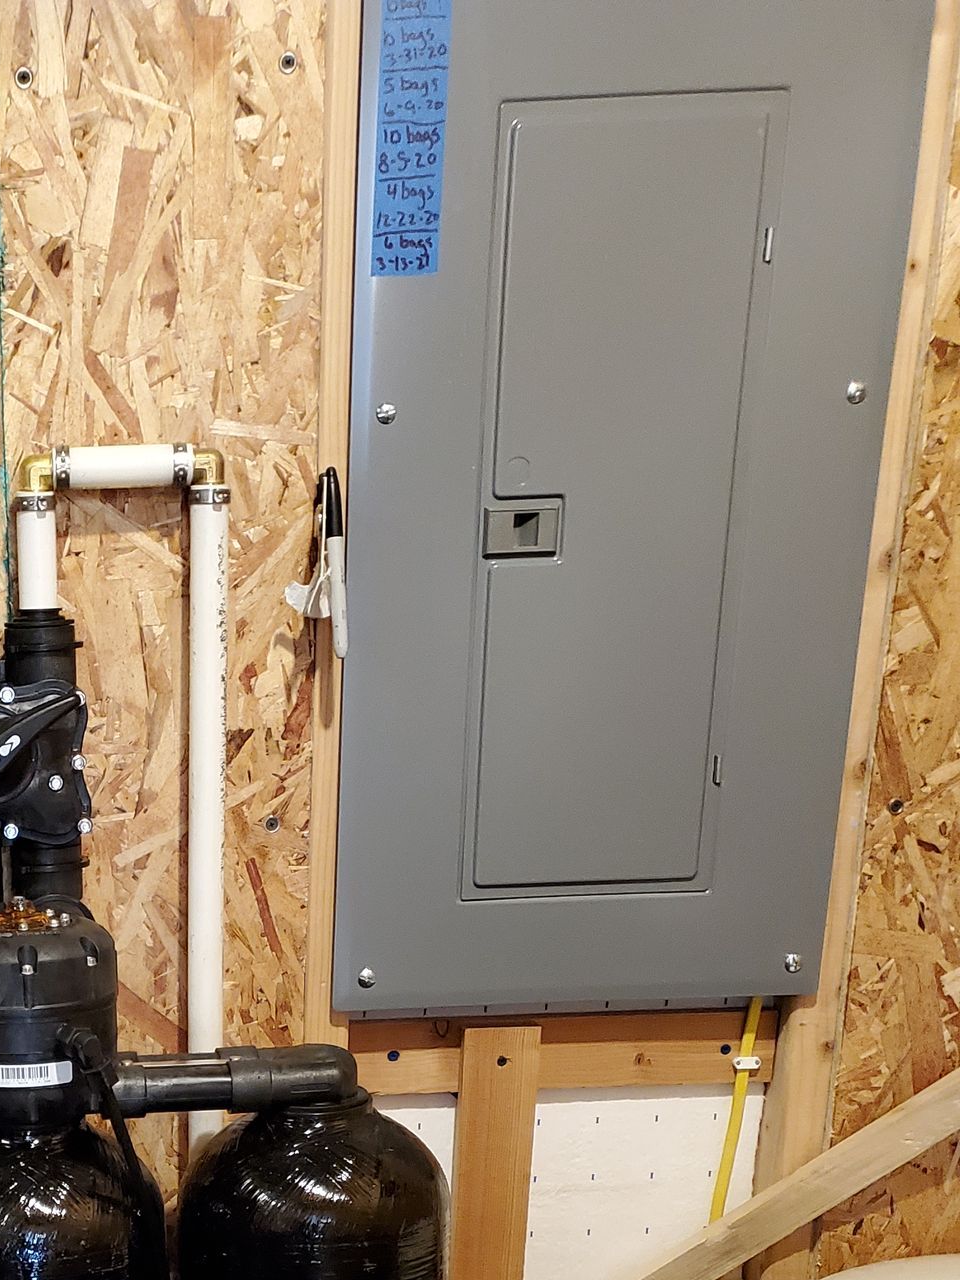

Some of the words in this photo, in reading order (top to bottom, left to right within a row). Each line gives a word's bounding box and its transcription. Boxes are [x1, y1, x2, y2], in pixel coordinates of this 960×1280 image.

[400, 26, 435, 51] bags
[383, 77, 395, 95] 5
[400, 76, 439, 97] bags
[383, 128, 402, 144] 10
[406, 125, 440, 151] bags
[387, 183, 397, 200] 4
[401, 180, 435, 210] bags
[384, 236, 393, 249] 6
[399, 234, 433, 257] bags
